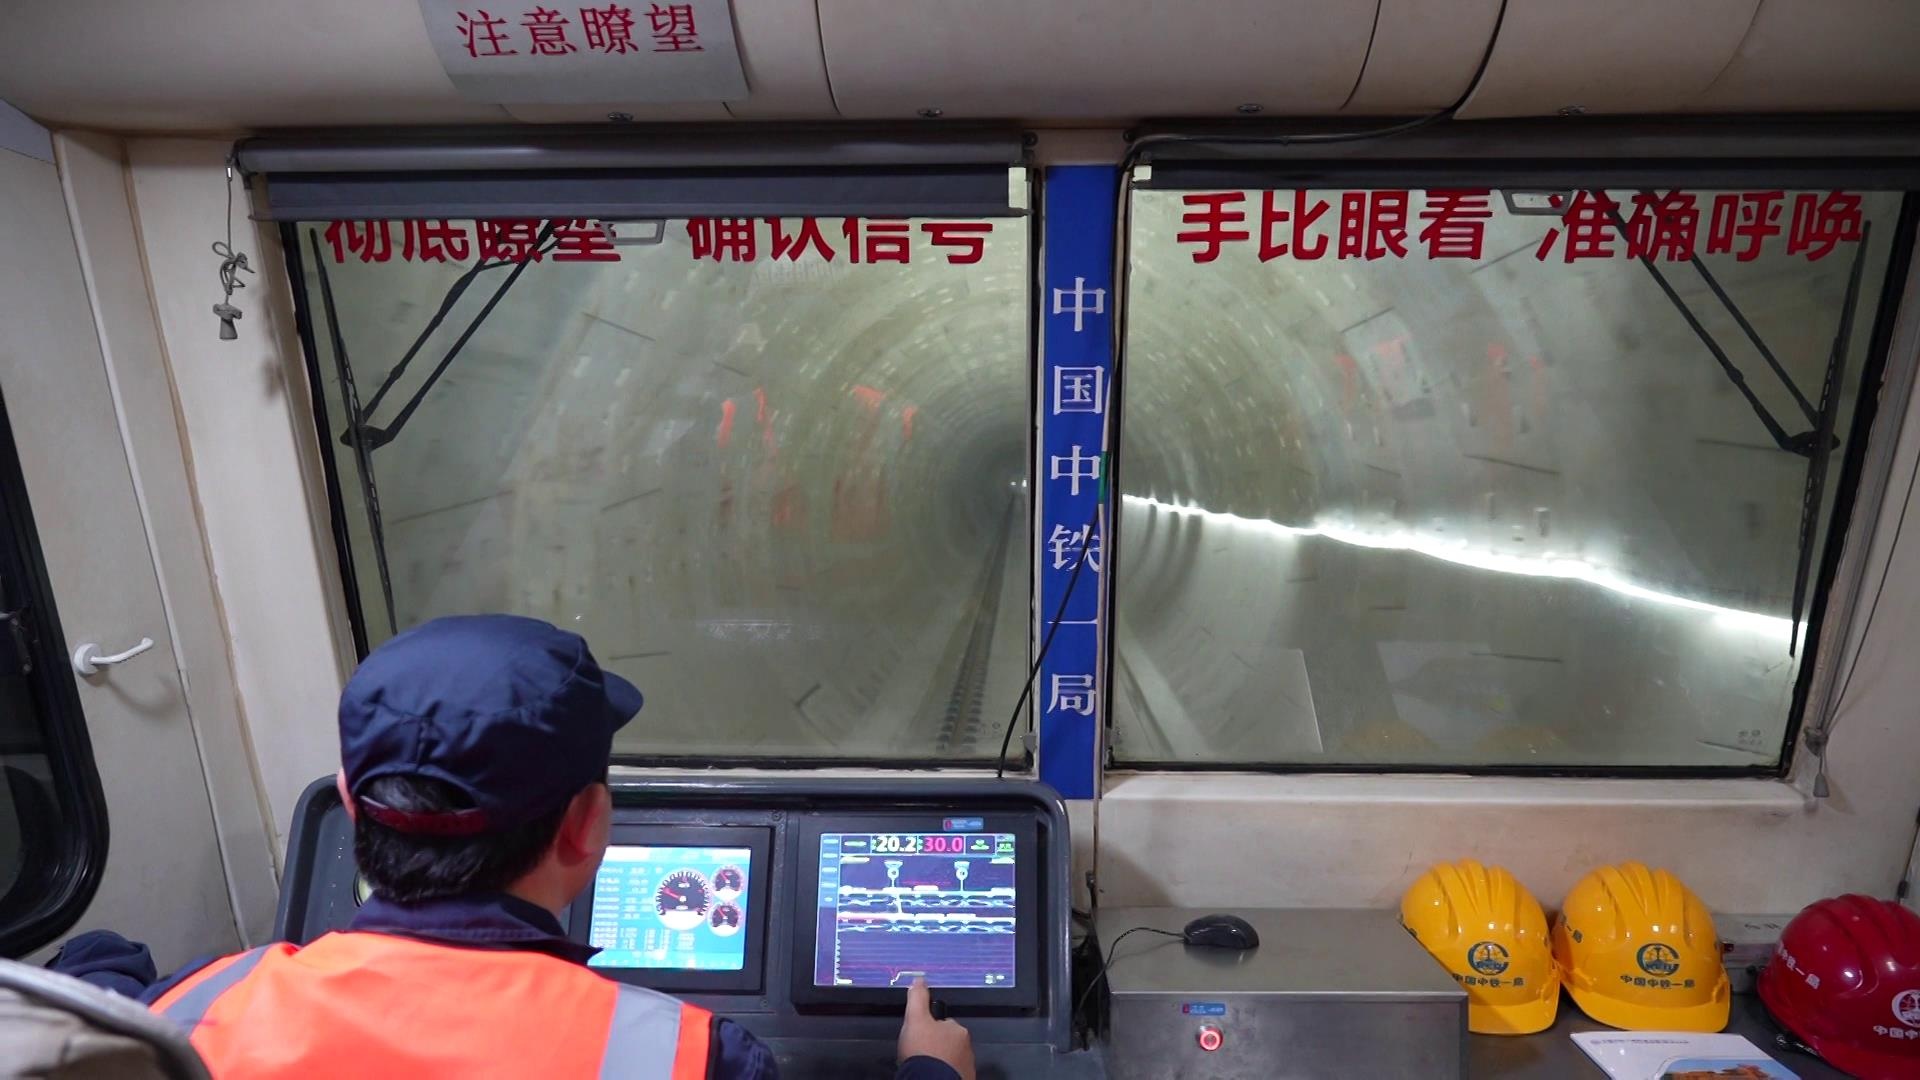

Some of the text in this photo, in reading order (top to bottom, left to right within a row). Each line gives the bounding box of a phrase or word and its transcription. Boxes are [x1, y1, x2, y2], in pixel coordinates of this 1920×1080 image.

[457, 4, 704, 57] 注意瞭望
[1177, 190, 1864, 264] 手比眼看 准确呼唤
[1047, 277, 1106, 716] 中国中铁一局
[877, 836, 917, 852] 20.2
[923, 837, 963, 852] 30.0
[1873, 1025, 1920, 1040] 中国中
